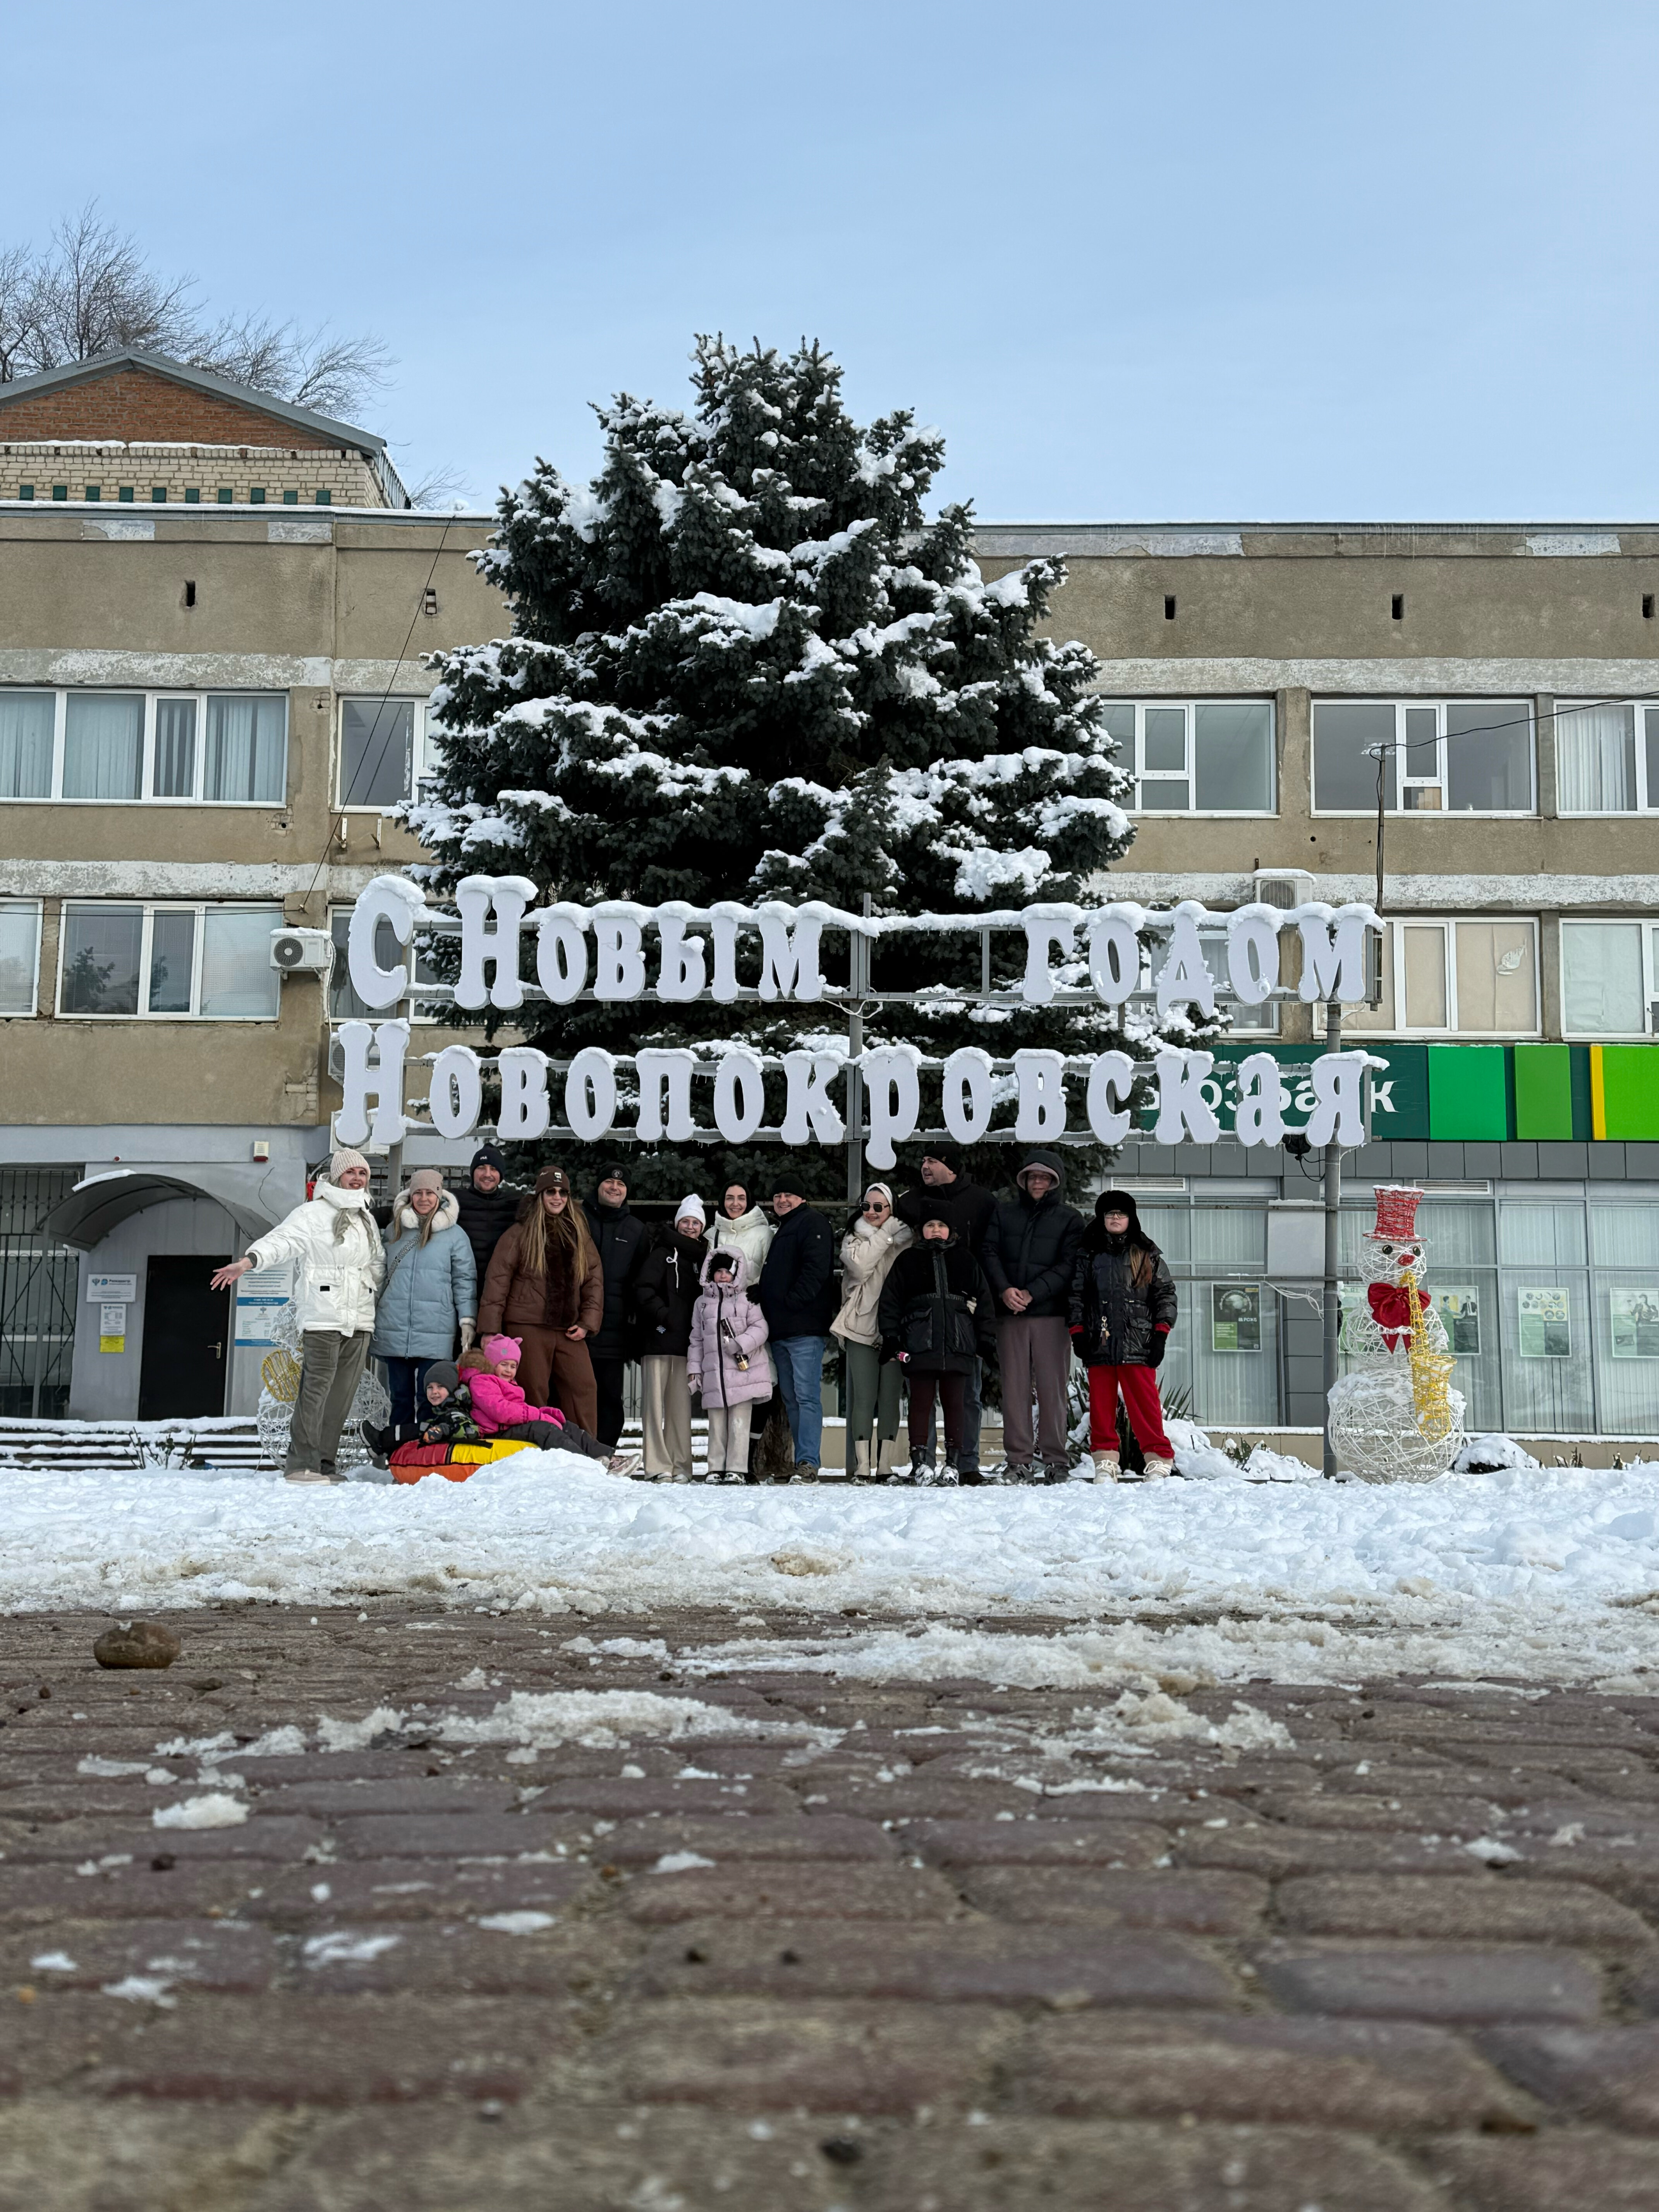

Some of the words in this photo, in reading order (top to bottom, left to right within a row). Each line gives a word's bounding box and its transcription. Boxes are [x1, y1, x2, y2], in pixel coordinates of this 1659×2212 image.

[348, 876, 426, 1010] С
[453, 878, 824, 1010] Новым
[335, 1019, 1365, 1171] Новопокровская
